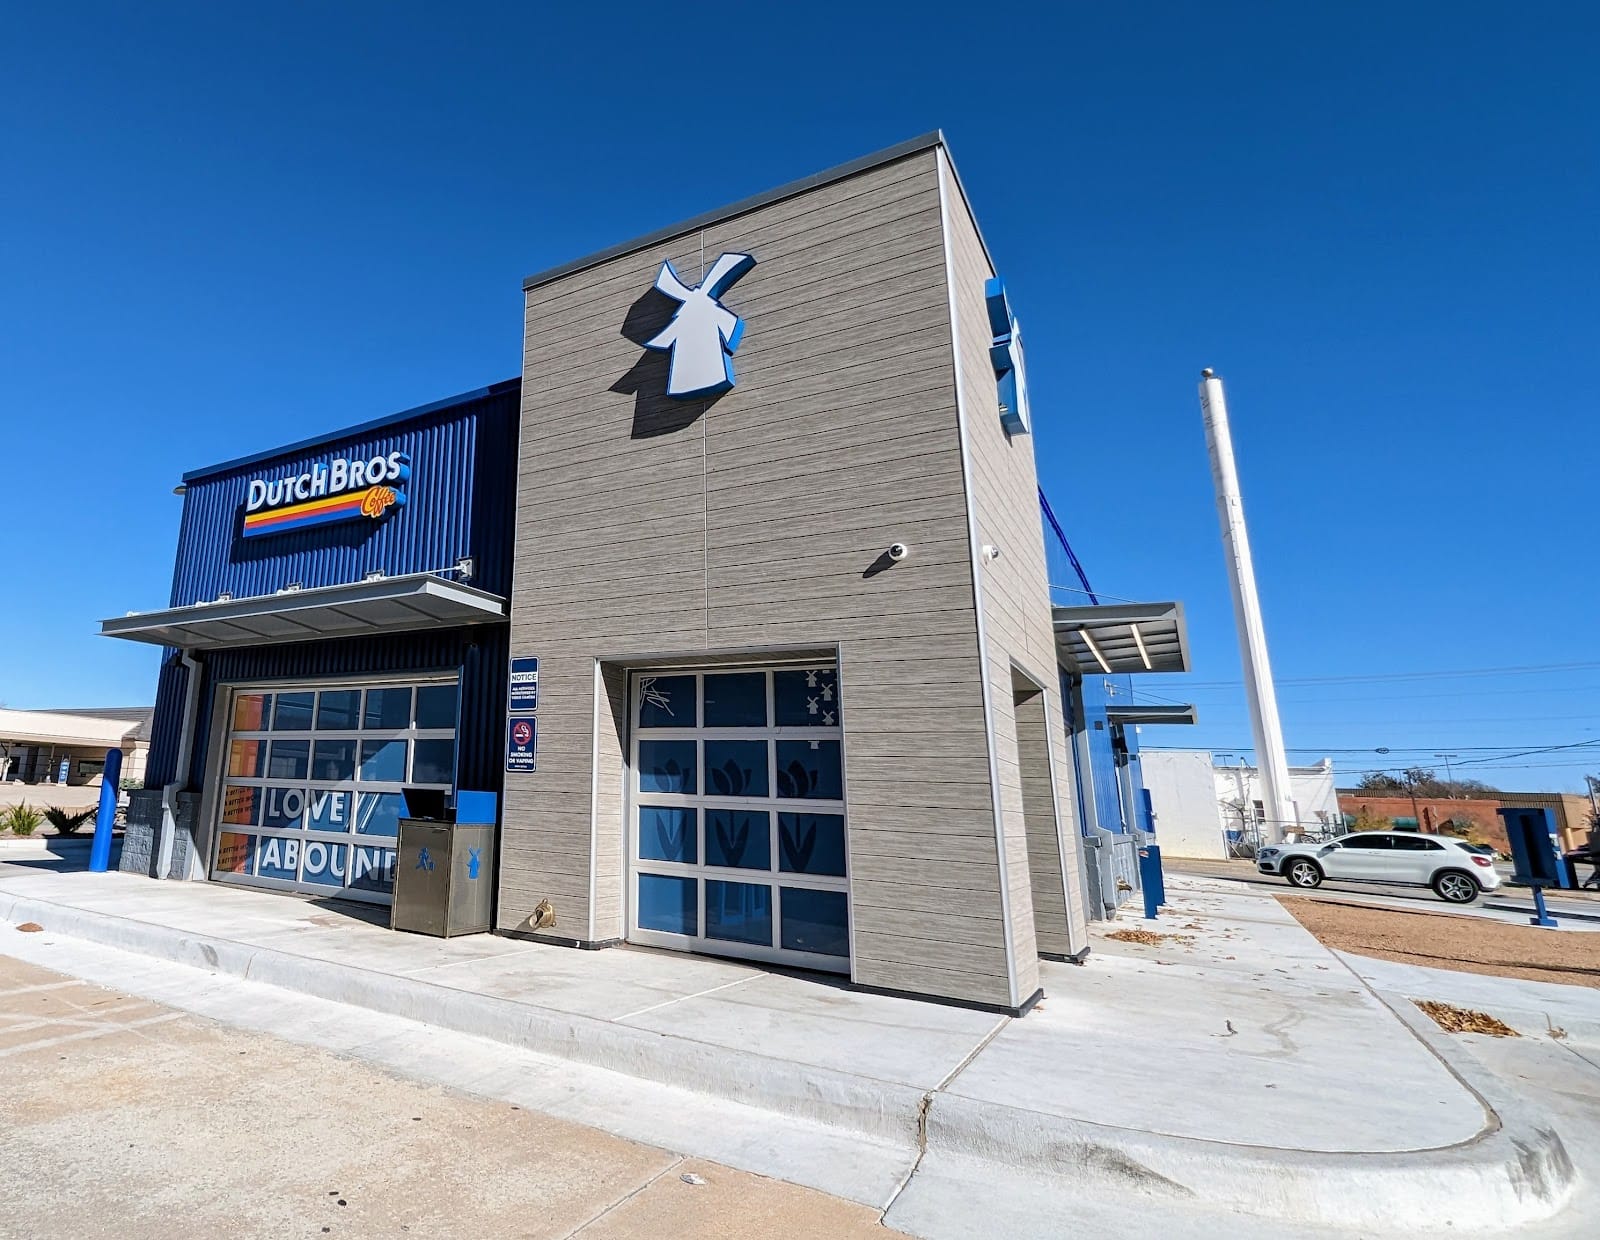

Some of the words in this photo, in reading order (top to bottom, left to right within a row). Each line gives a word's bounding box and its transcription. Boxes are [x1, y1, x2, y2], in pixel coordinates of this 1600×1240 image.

[329, 452, 401, 493] BROS
[361, 485, 396, 518] Coffee
[512, 673, 537, 681] NOTICE
[268, 788, 345, 822] LOVE
